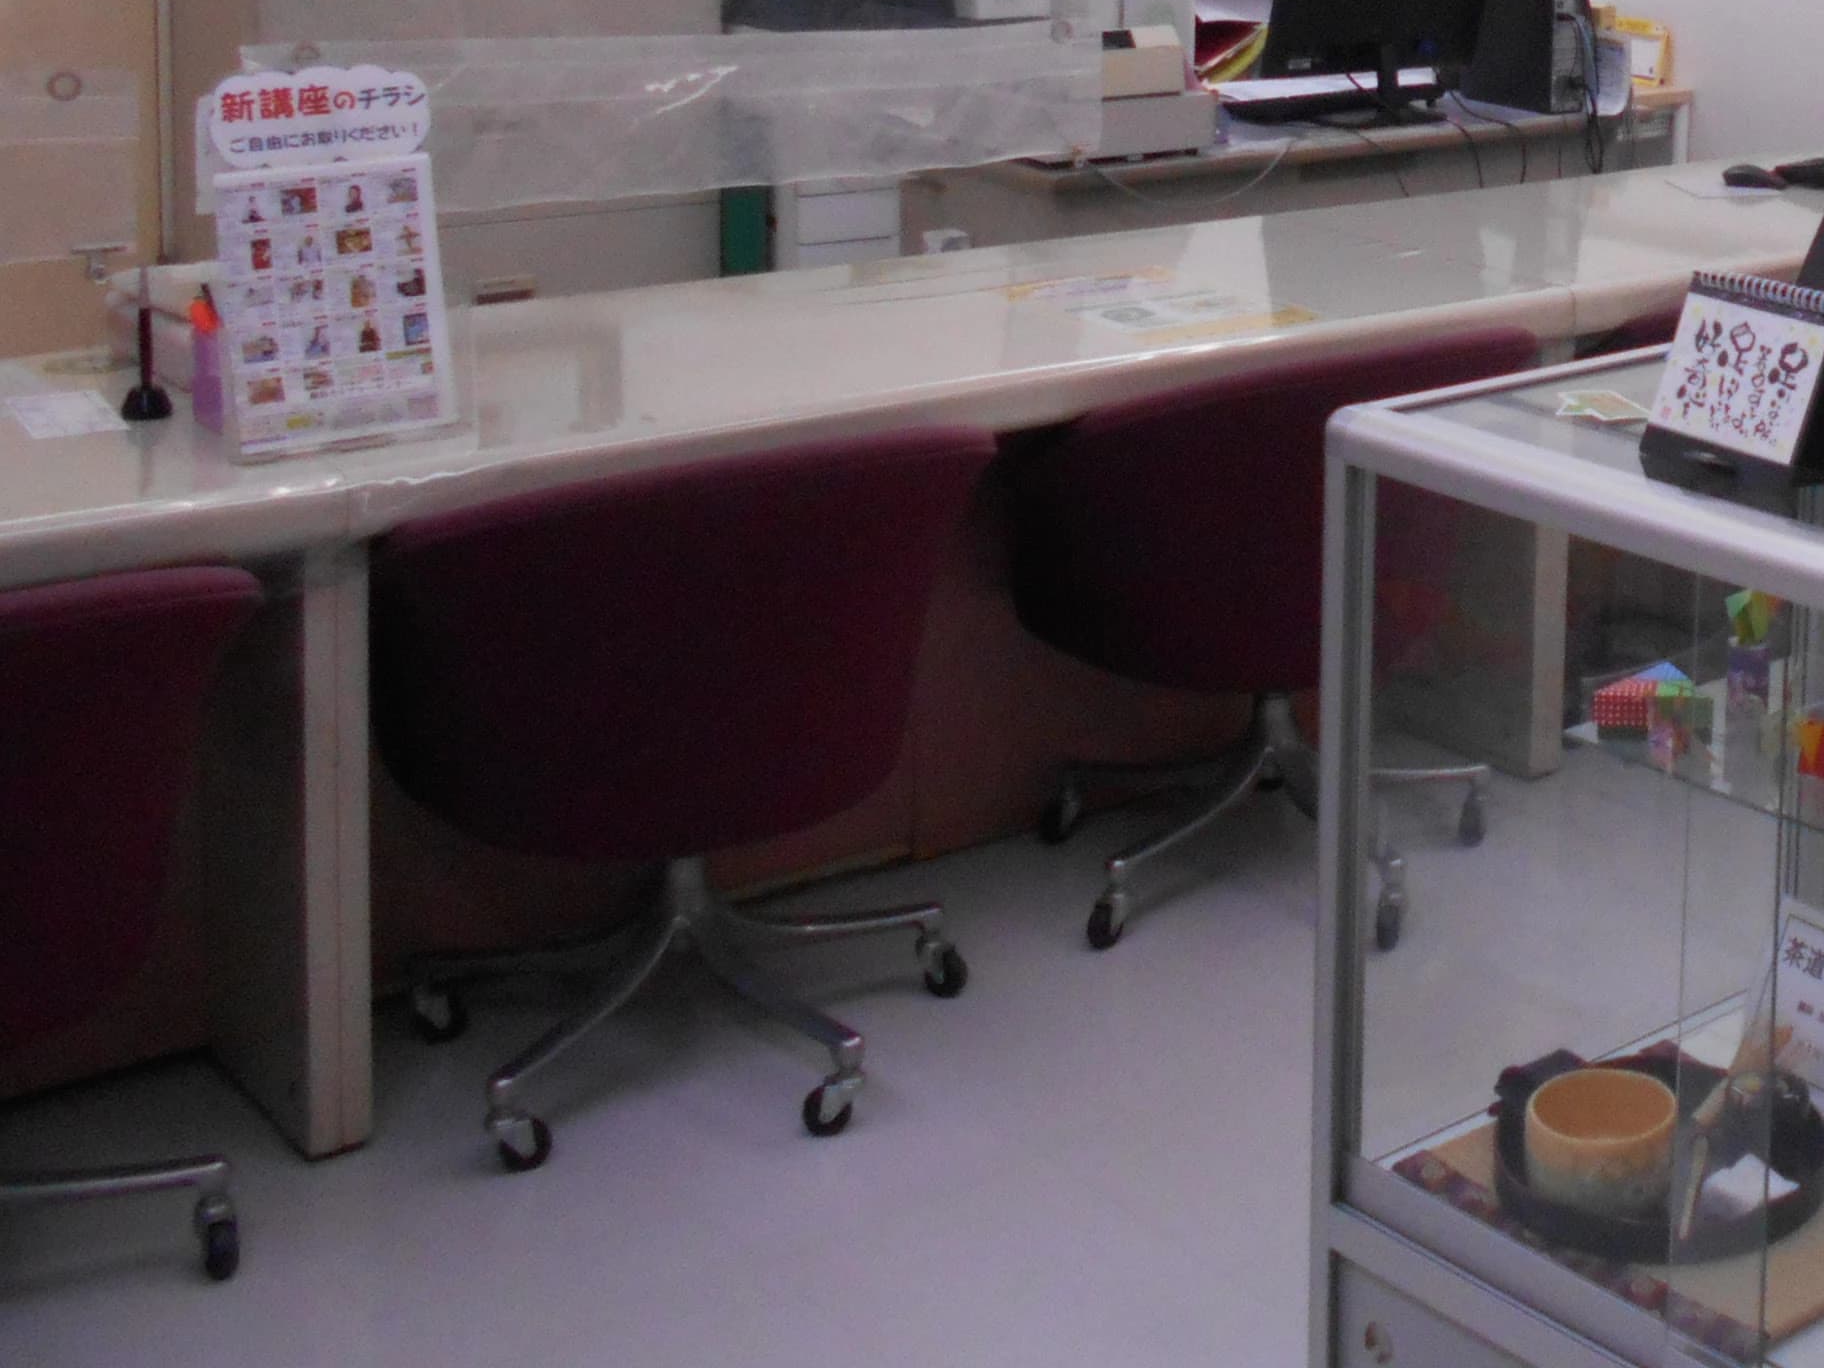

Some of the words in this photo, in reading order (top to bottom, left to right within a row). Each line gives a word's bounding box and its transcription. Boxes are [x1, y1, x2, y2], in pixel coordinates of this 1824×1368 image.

[220, 84, 426, 124] 新講座のチラシ
